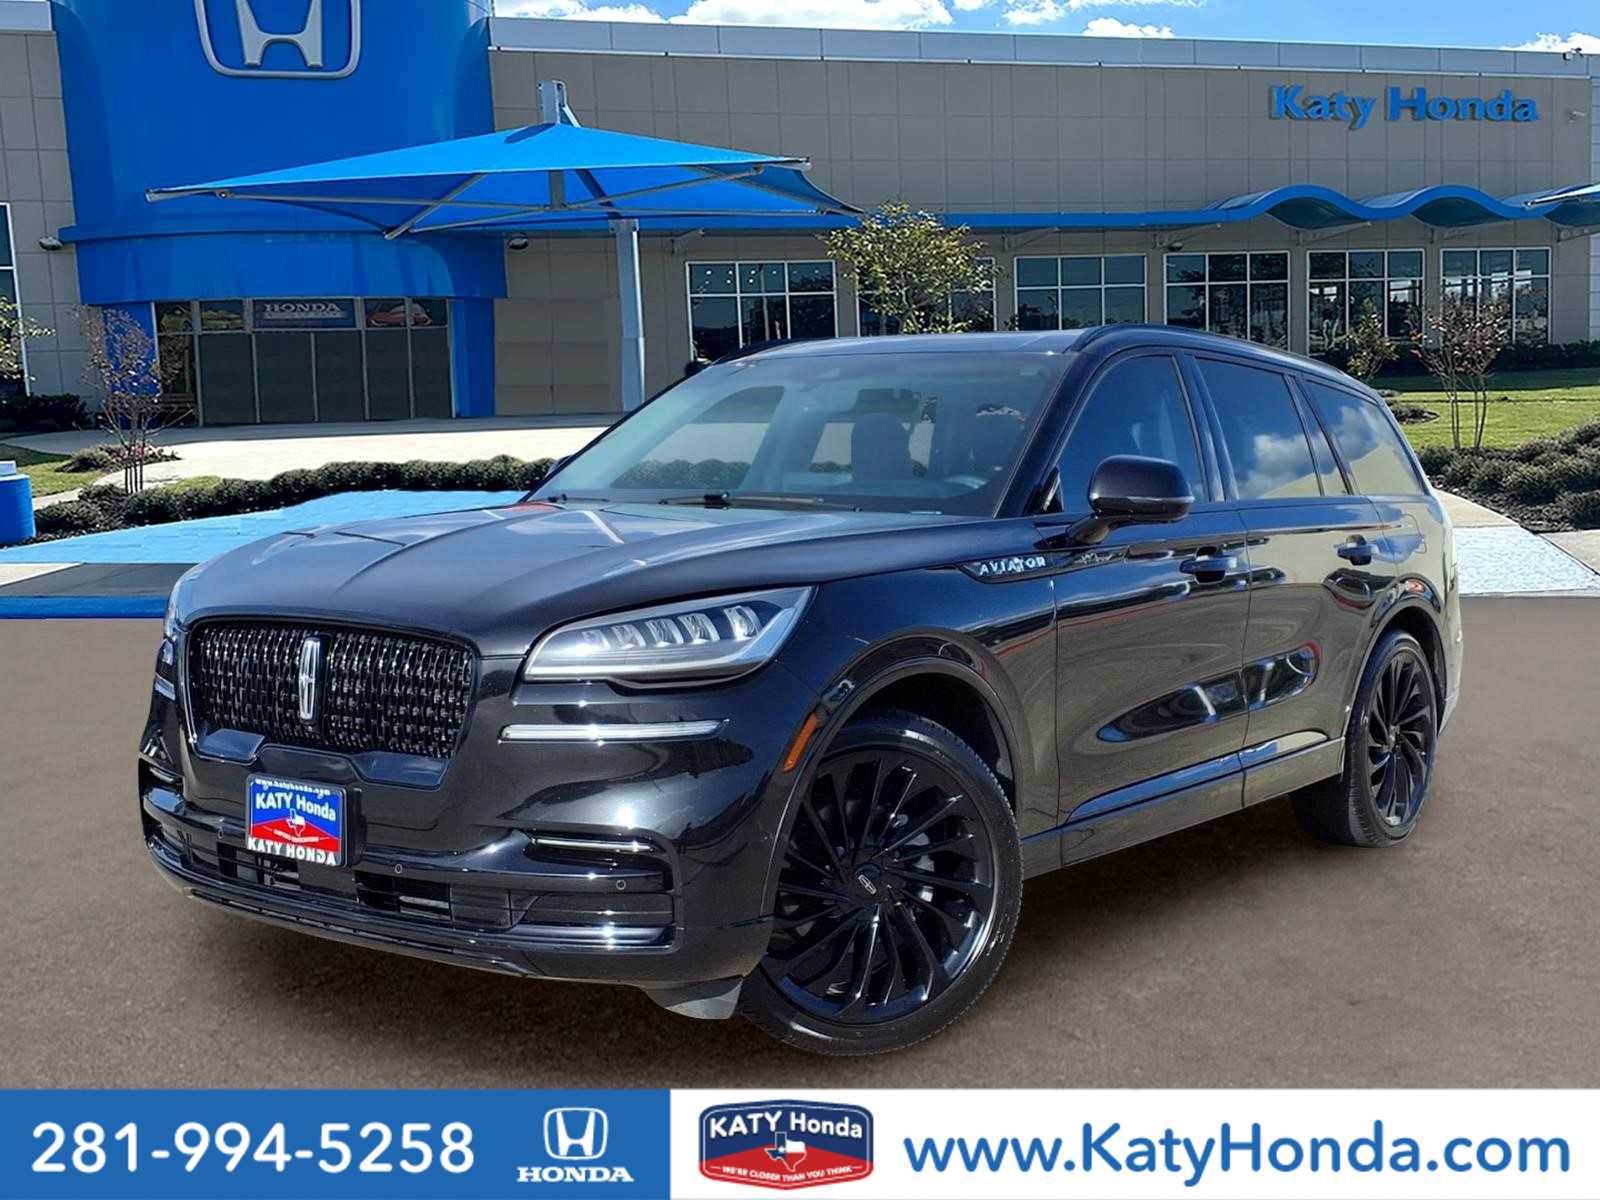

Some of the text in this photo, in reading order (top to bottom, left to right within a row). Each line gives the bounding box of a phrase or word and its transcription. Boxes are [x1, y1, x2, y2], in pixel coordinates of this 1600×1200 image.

[1270, 84, 1538, 130] Katy Honda
[264, 303, 341, 313] HONDA
[980, 556, 1046, 575] AVIATOR
[256, 792, 336, 821] KATY Honda
[248, 836, 337, 866] KATY HONDA
